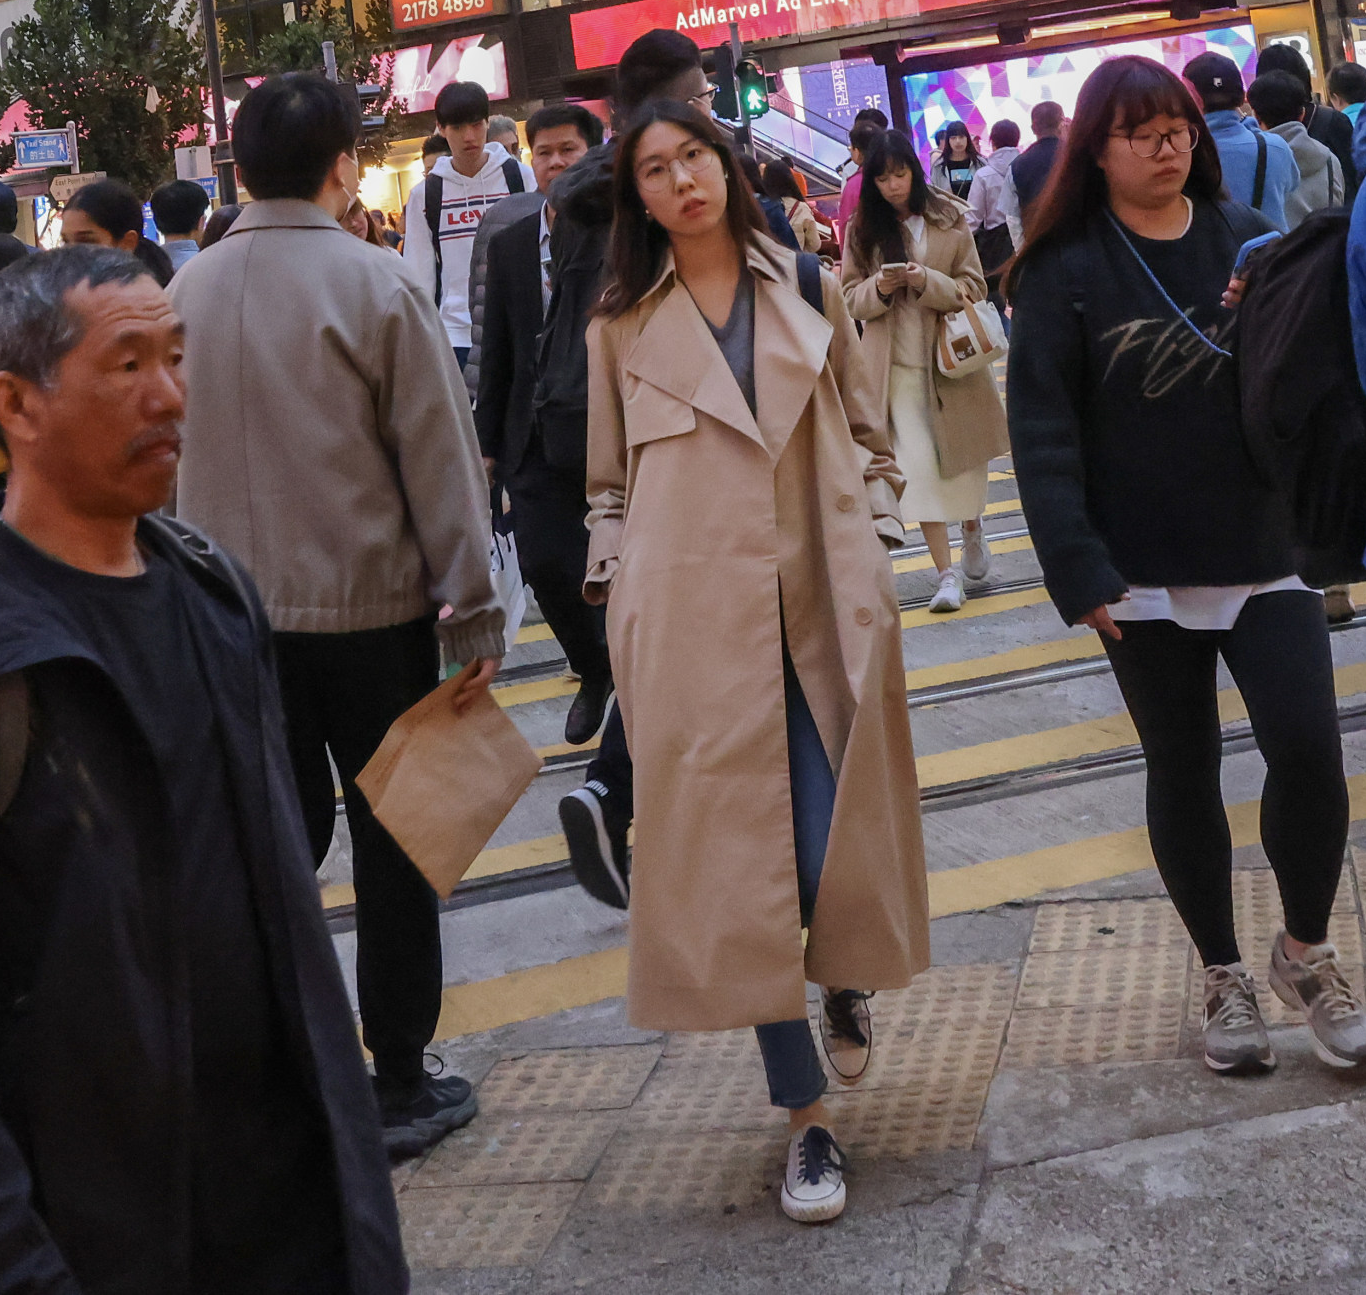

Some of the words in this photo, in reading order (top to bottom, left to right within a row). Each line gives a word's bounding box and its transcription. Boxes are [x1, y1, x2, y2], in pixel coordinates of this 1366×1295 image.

[402, 0, 438, 22] 2178
[676, 1, 768, 31] AdMarvel
[25, 140, 37, 148] Taxi
[38, 138, 57, 147] Stand
[30, 150, 55, 160] 的士站
[55, 178, 65, 187] East
[447, 209, 485, 225] Lev
